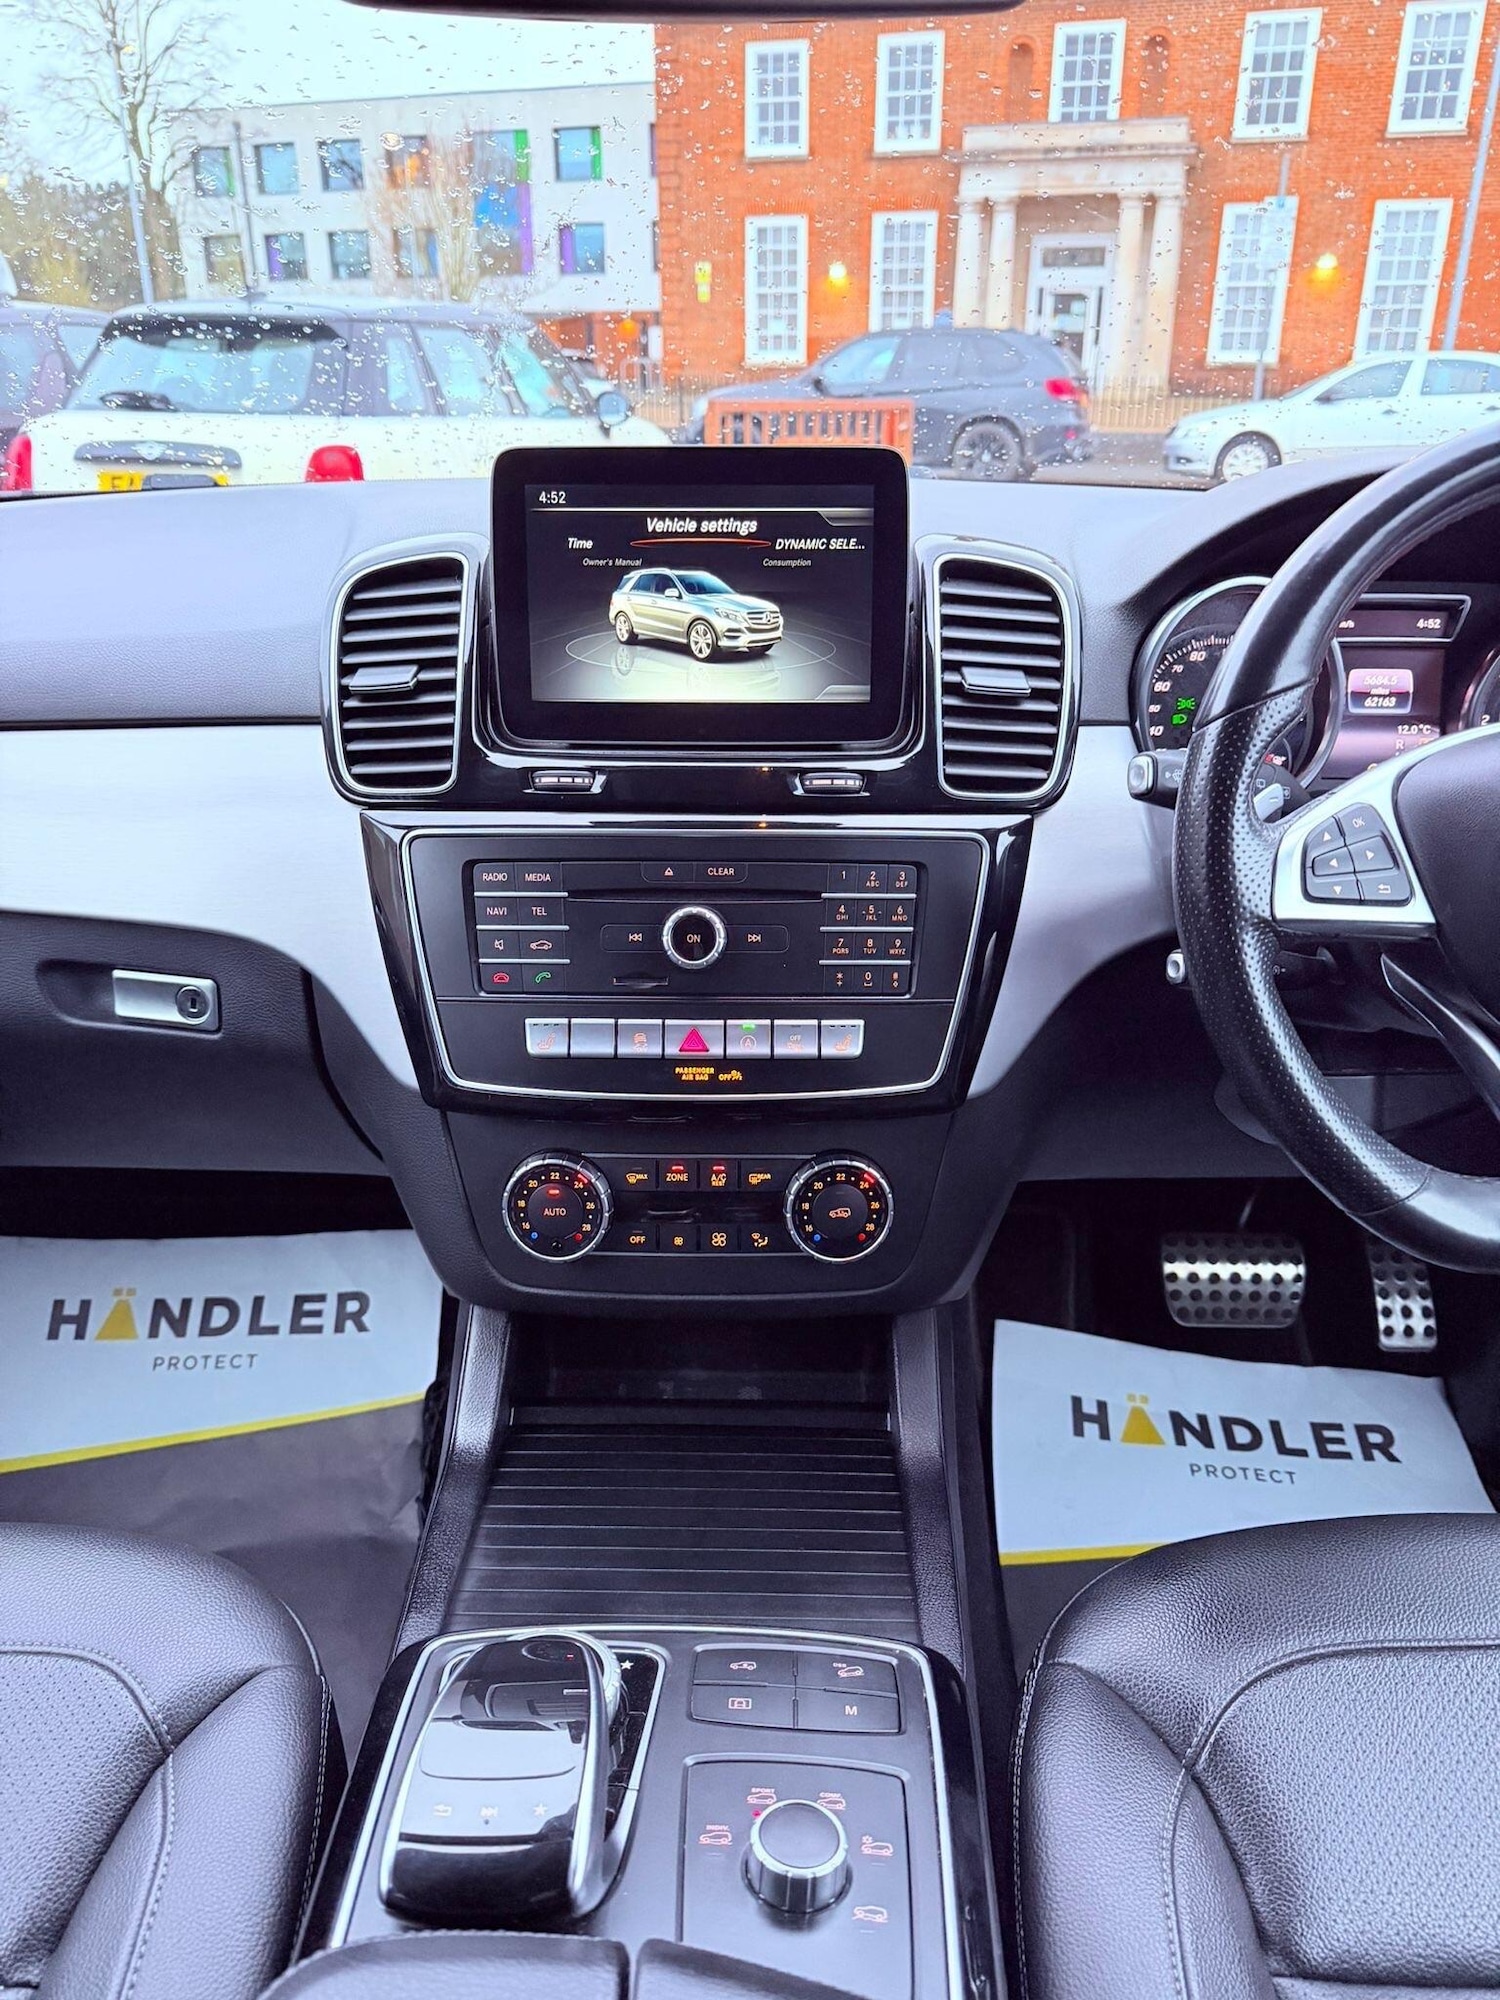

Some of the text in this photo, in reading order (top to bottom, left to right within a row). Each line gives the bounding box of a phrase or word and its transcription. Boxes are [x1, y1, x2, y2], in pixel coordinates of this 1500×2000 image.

[538, 491, 566, 504] 4:52
[646, 517, 758, 536] Vehicle settings
[568, 538, 594, 550] Time
[775, 538, 826, 550] DYNAMIC
[582, 558, 642, 566] Owner's Manual
[762, 558, 812, 568] Consumption
[1416, 618, 1442, 629] 4:52
[1189, 650, 1206, 662] 80
[1171, 664, 1184, 673] 70
[1364, 676, 1398, 685] 5684.5
[1154, 682, 1171, 692] 60
[1364, 696, 1396, 707] 62163
[1481, 714, 1490, 726] 2
[1396, 740, 1404, 750] R
[1352, 816, 1366, 828] OK
[482, 872, 508, 882] RADIO
[708, 868, 736, 876] CLEAR
[842, 870, 846, 880] 1
[870, 871, 876, 880] 2
[900, 872, 906, 880] 3
[524, 873, 552, 882] MEDIA
[486, 907, 507, 916] NAVI
[532, 907, 548, 916] TEL
[839, 904, 846, 914] 4
[868, 904, 874, 914] 5
[897, 906, 904, 914] 6
[686, 933, 701, 943] ON
[838, 938, 844, 947] 7
[867, 938, 874, 947] 8
[895, 938, 902, 948] 9
[674, 1066, 715, 1074] PASSENGER
[666, 1173, 688, 1182] ZONE
[710, 1173, 727, 1182] A/C
[544, 1208, 567, 1216] AUTO
[582, 1224, 592, 1232] 28
[865, 1223, 875, 1231] 28
[630, 1236, 646, 1244] OFF
[46, 1288, 371, 1341] HÄNDLER
[152, 1353, 259, 1372] PROTECT
[1070, 1392, 1403, 1464] HÄNDLER
[1188, 1462, 1298, 1485] PROTECT
[844, 1705, 858, 1716] M
